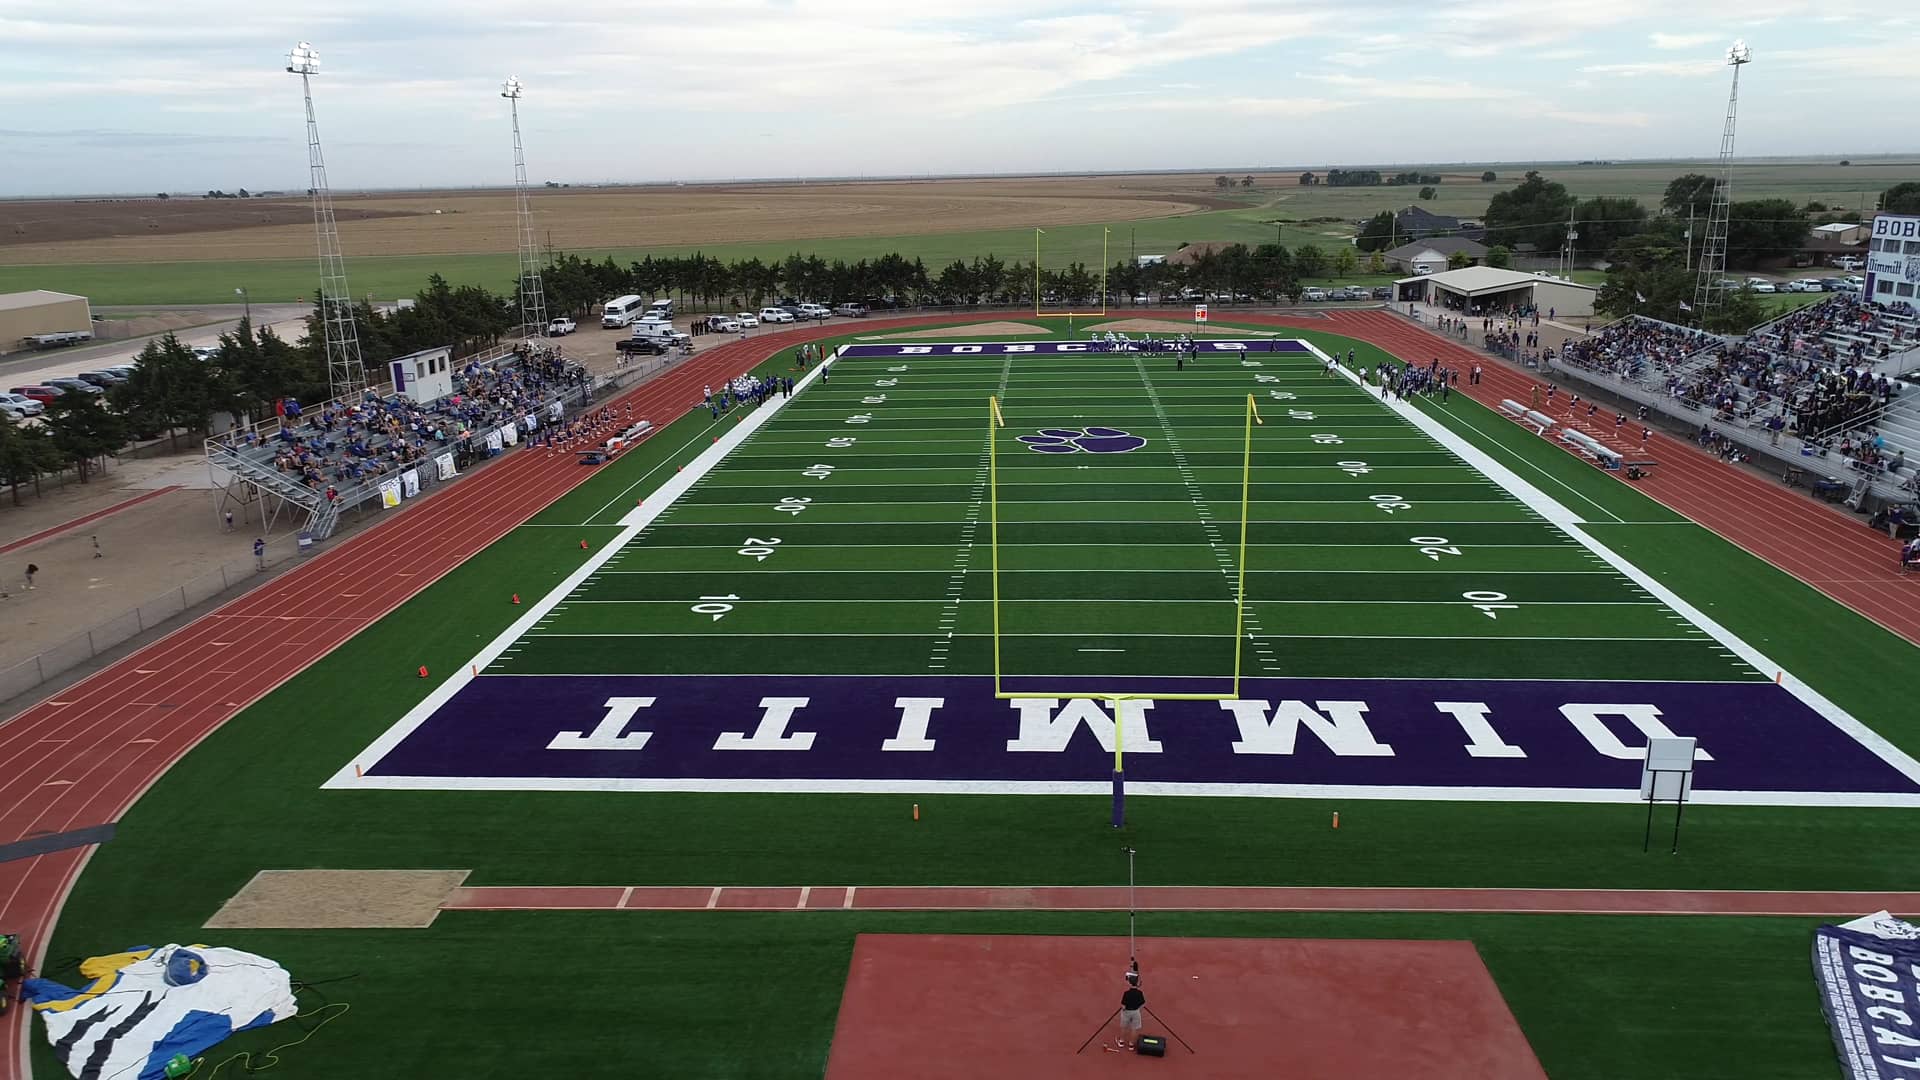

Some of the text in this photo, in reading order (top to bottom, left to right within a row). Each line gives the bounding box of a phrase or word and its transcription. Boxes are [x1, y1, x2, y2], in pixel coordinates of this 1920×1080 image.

[1876, 220, 1920, 238] BOB
[897, 343, 1248, 354] BOBCS
[825, 437, 856, 448] 50
[1309, 433, 1344, 444] 50
[801, 463, 836, 477] 40
[1336, 461, 1374, 474] 40
[773, 496, 812, 512] 30
[1368, 494, 1412, 510] 30
[737, 537, 782, 555] 20
[1409, 536, 1463, 555] 20
[690, 593, 741, 614] 10
[1462, 590, 1519, 609] 10
[545, 696, 1715, 760] DIMMITT
